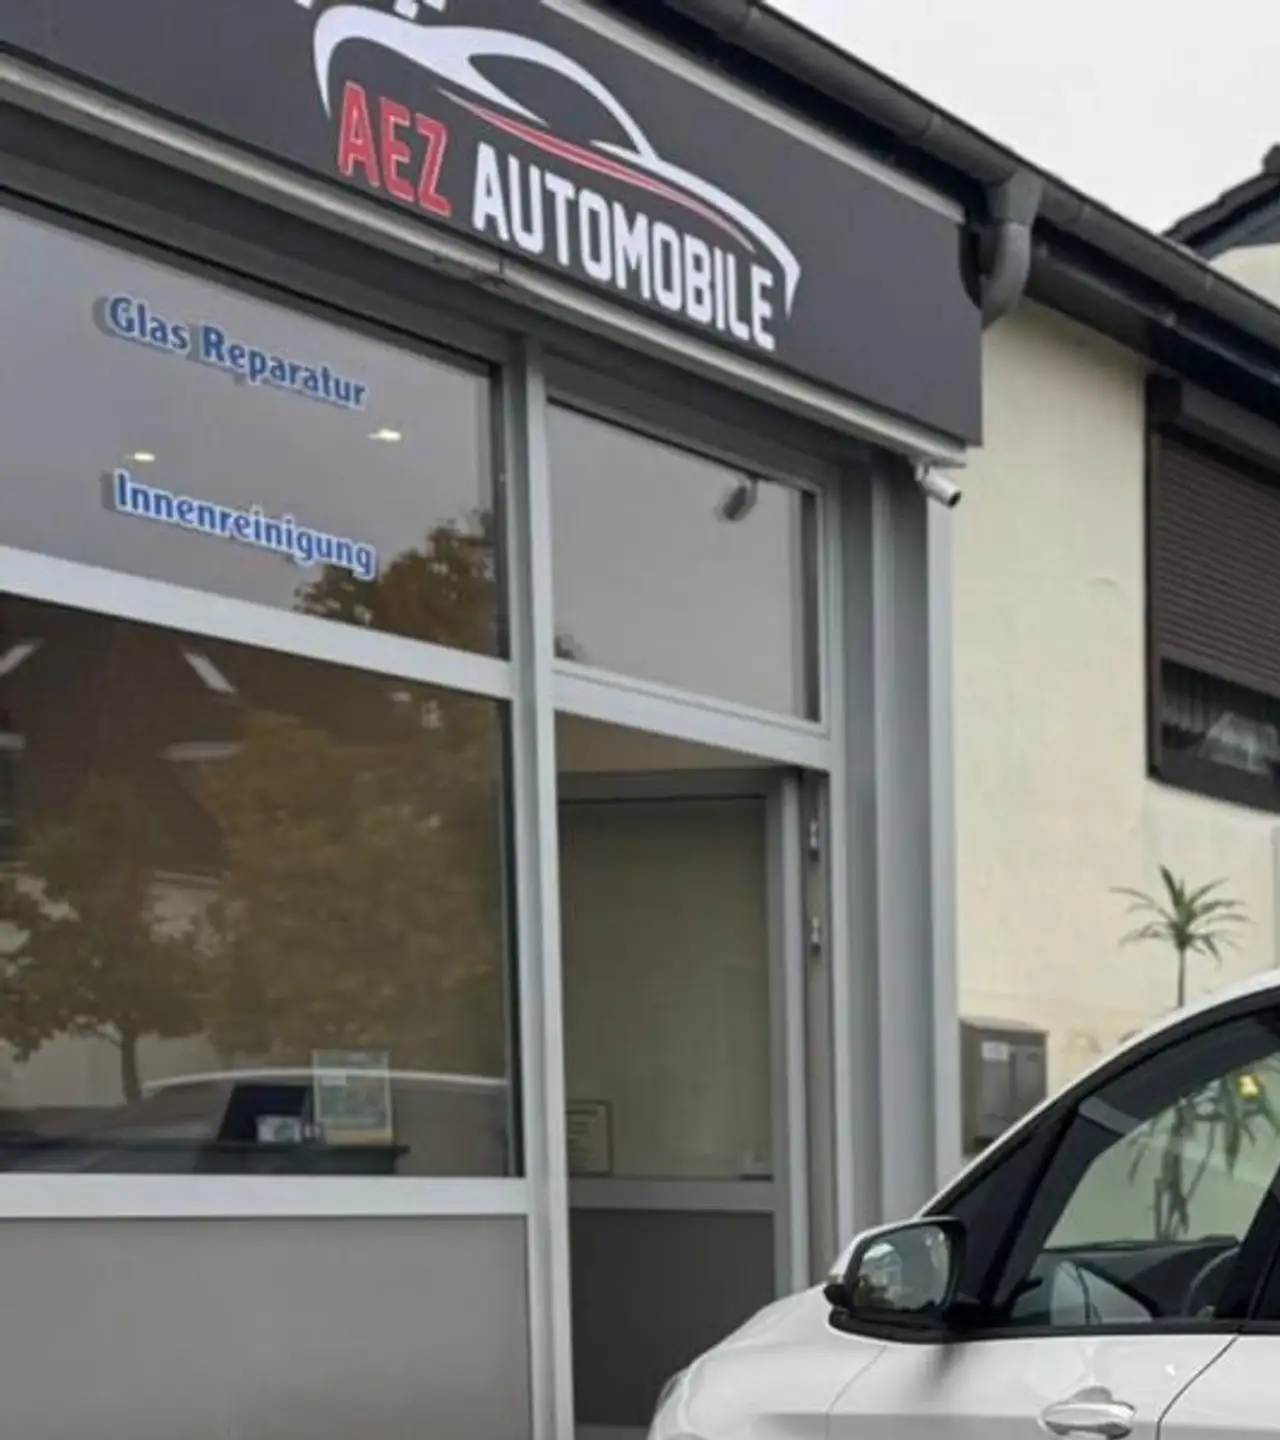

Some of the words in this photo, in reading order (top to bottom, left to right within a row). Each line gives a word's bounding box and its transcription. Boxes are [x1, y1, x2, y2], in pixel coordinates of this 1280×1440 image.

[336, 79, 451, 217] AEZ
[471, 143, 776, 352] AUTOMOBILE
[106, 295, 191, 355] Glas
[201, 325, 367, 409] Reparatur
[115, 472, 378, 580] Innenreinigung
